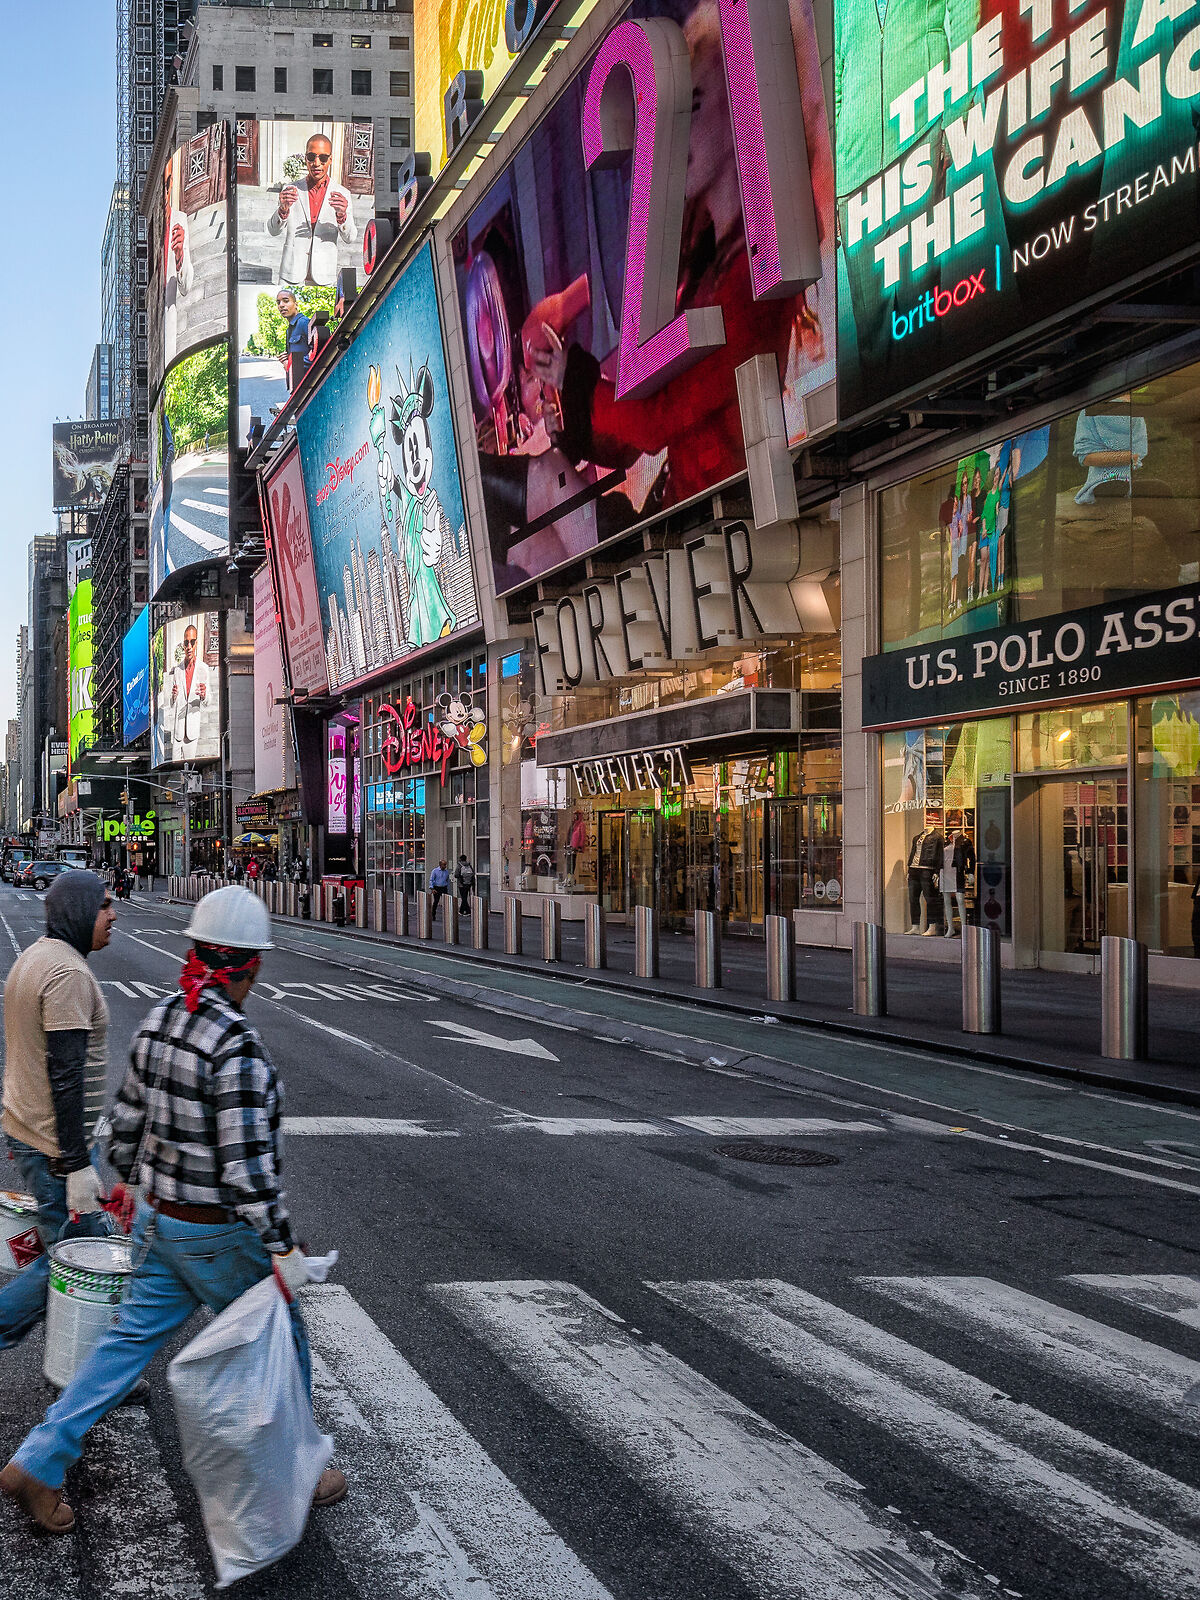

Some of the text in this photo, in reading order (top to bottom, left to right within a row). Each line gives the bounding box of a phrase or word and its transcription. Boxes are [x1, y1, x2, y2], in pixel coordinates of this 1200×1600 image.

[890, 12, 1005, 144] THE
[847, 143, 934, 248] HIS
[944, 8, 1109, 172] WIFE
[581, 0, 783, 402] 21
[874, 174, 986, 289] THE
[1012, 216, 1075, 273] NOW
[892, 268, 986, 341] britbox
[69, 433, 95, 450] Harry
[83, 422, 118, 430] BROADWAY
[531, 519, 768, 697] FOREVER
[905, 595, 1200, 690] U.S. POLO ASS
[998, 665, 1102, 696] SINCE 1890
[571, 747, 691, 797] FOREVER 21
[237, 806, 267, 816] ELECTRONICS
